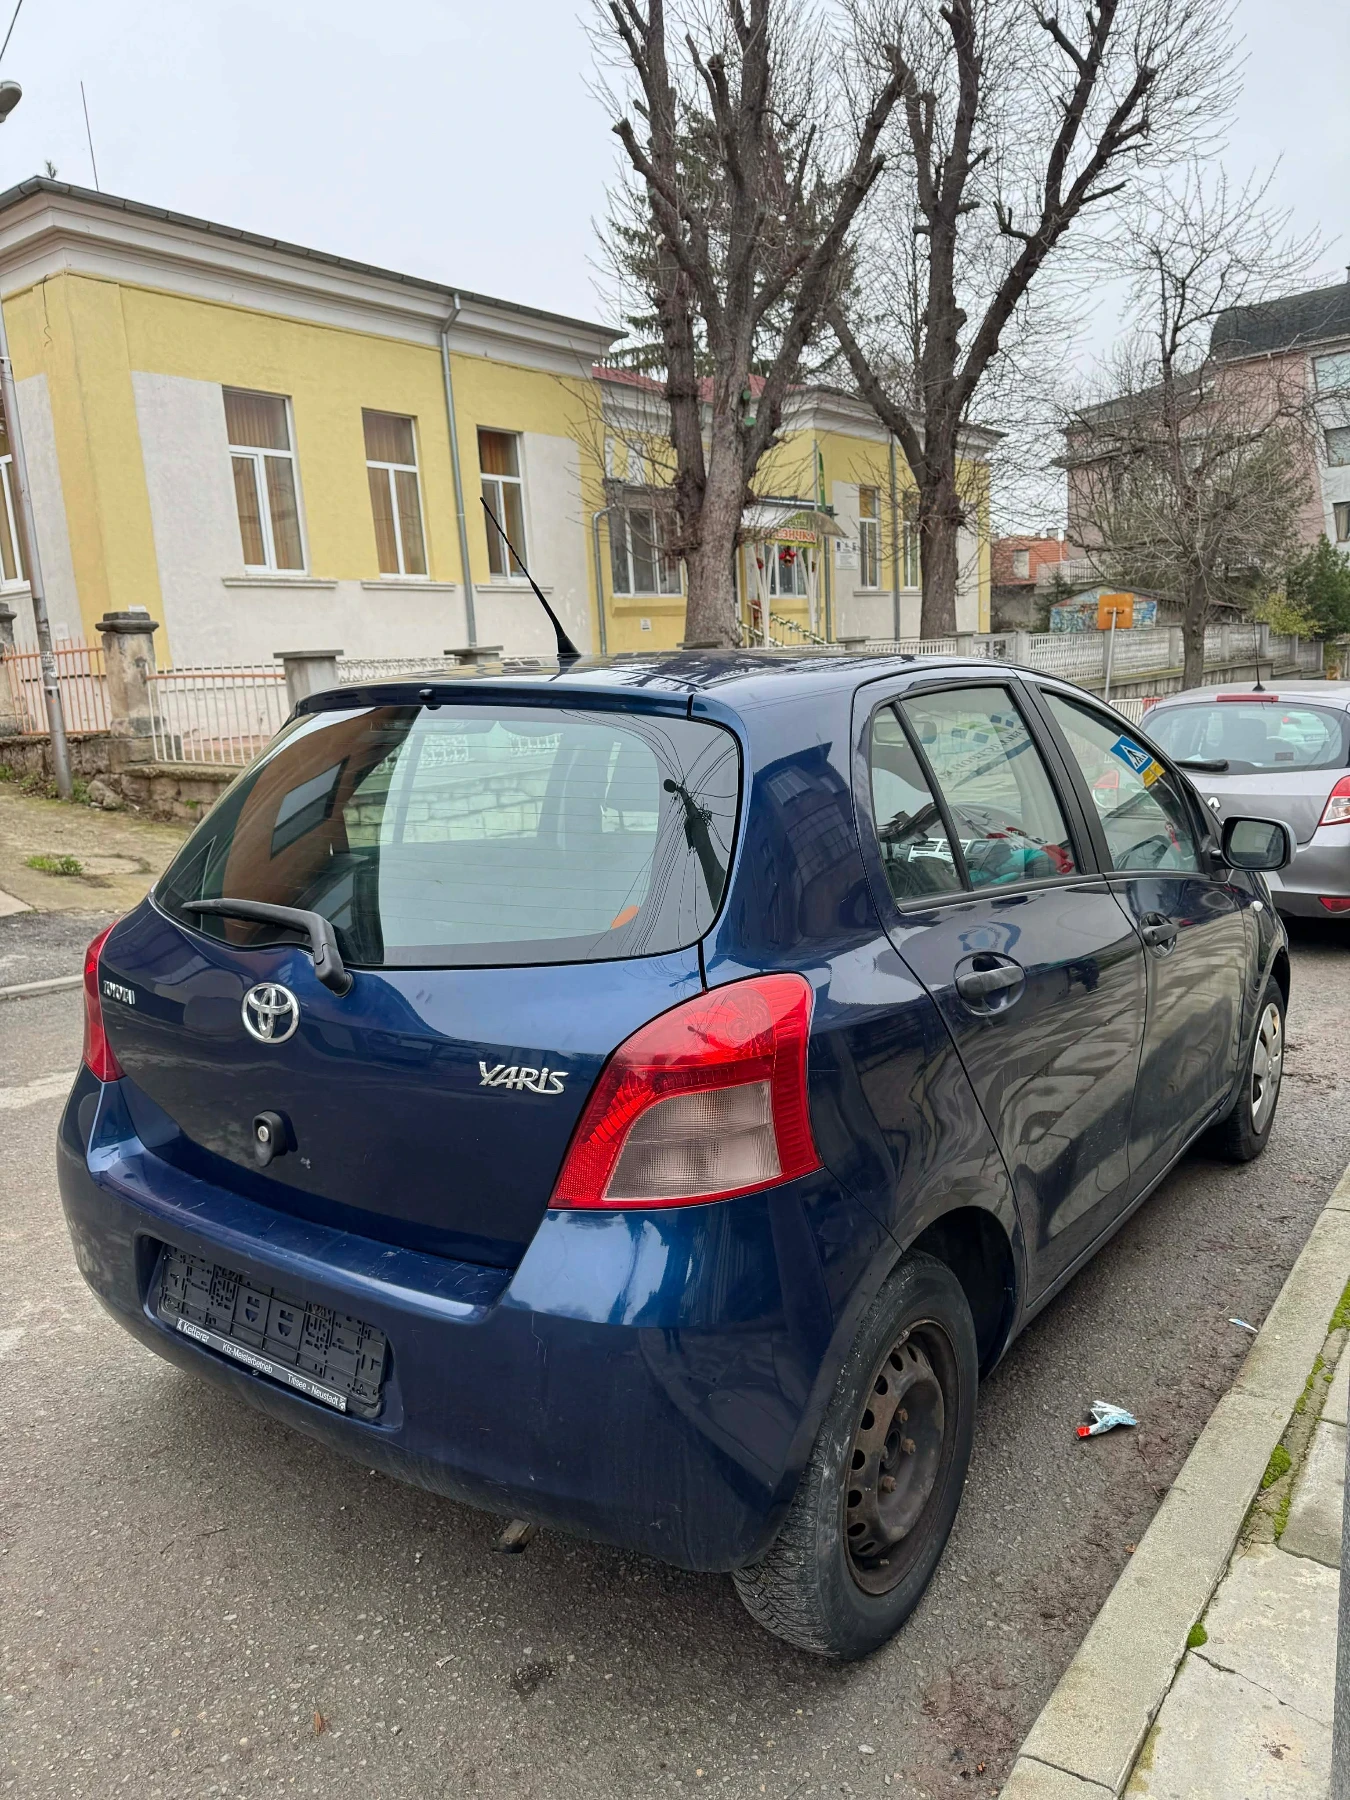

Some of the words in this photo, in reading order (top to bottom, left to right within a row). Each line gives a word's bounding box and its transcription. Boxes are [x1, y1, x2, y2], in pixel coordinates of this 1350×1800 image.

[182, 1321, 210, 1343] Ketterer
[222, 1343, 273, 1374] Kfz-Meisterbetrieb
[311, 1384, 339, 1406] Neustadt
